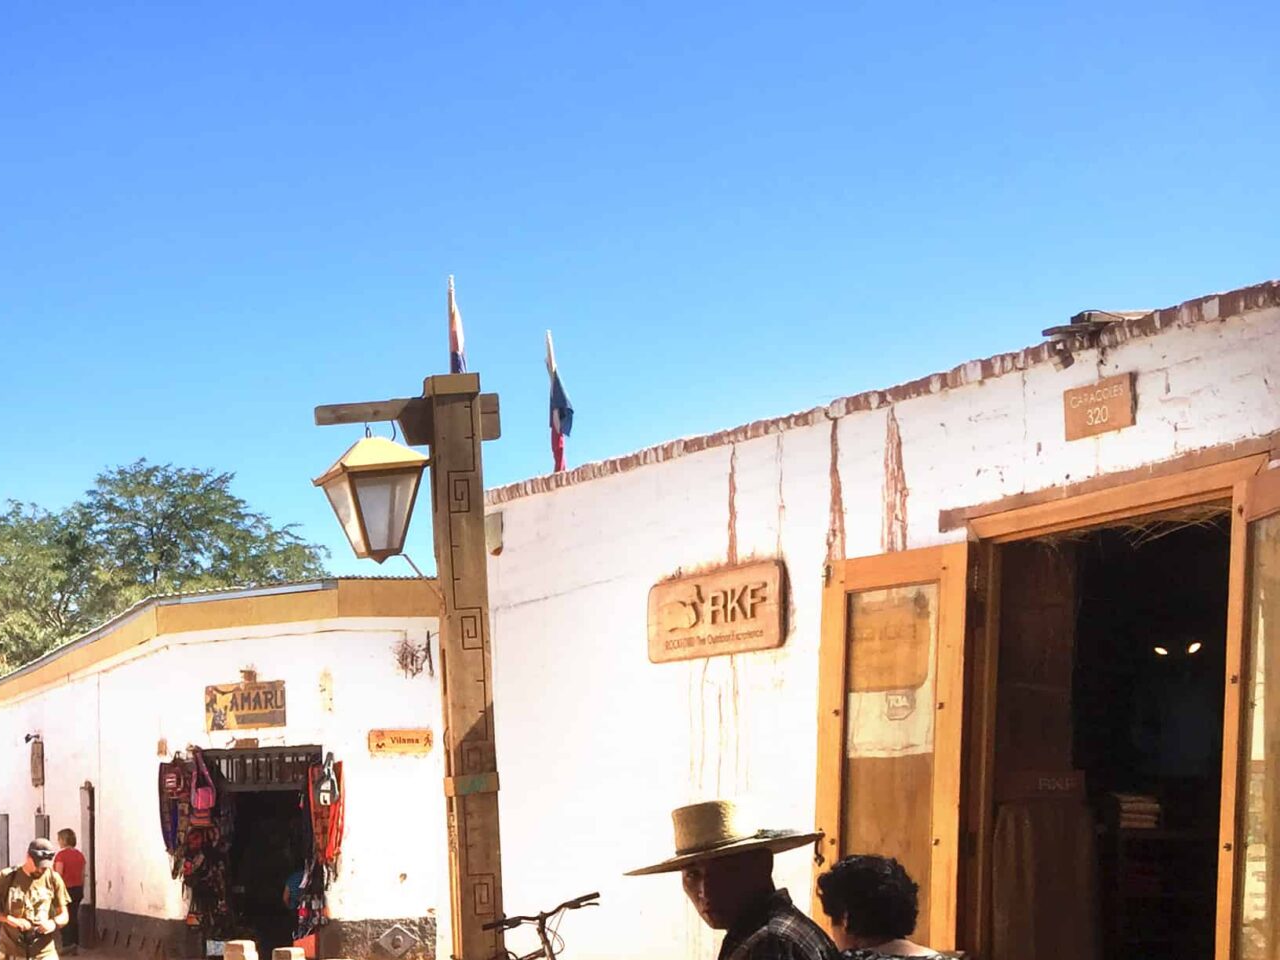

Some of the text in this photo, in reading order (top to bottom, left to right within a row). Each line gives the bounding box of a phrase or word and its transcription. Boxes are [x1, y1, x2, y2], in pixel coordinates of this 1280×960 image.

[1086, 406, 1109, 426] 320
[709, 581, 768, 625] RKF
[389, 736, 420, 745] Vilama
